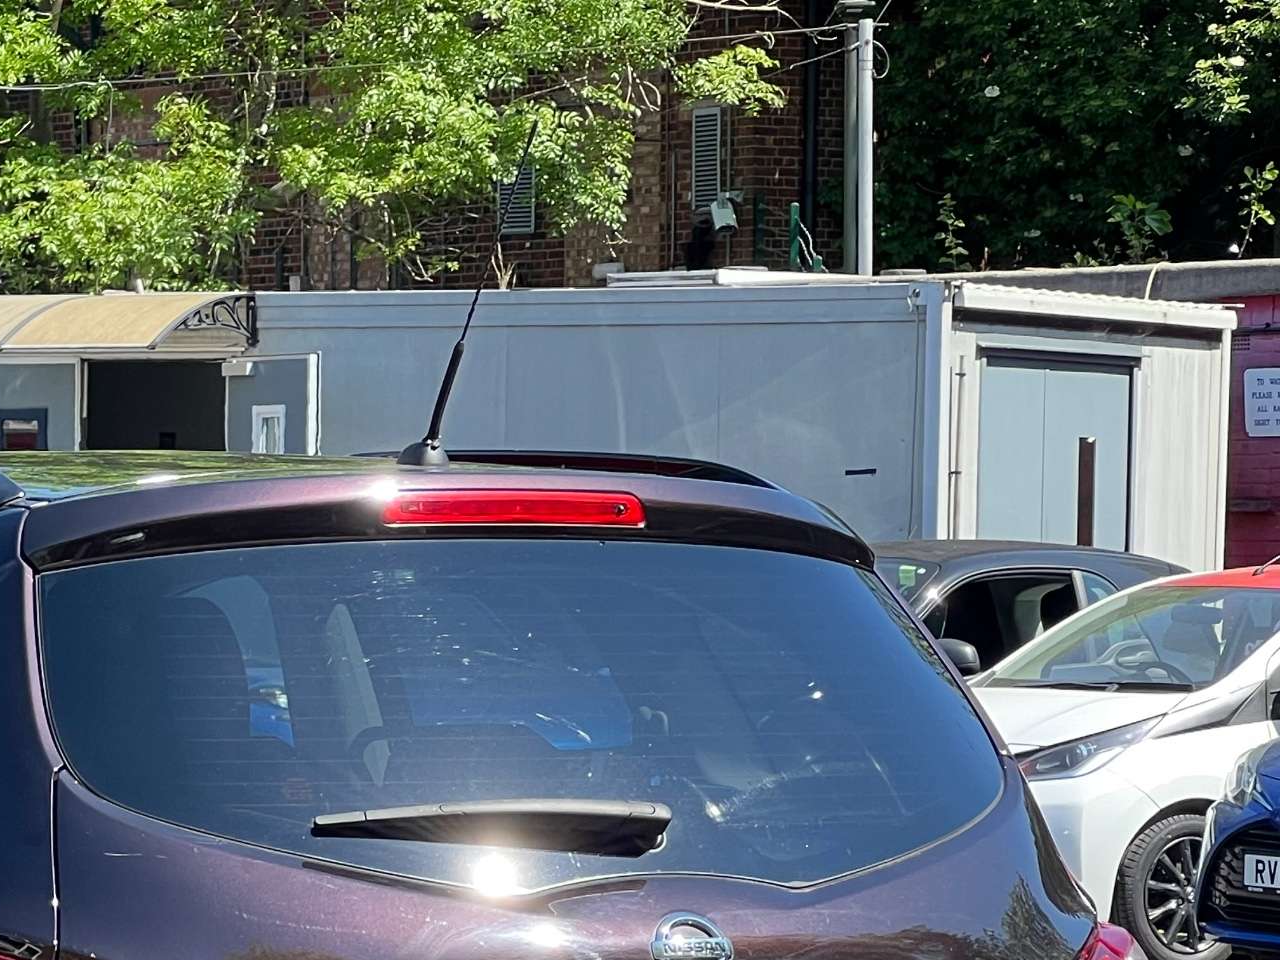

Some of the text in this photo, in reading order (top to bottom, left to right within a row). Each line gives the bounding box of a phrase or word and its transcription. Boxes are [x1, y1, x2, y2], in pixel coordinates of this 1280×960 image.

[1252, 391, 1272, 399] PLEASE
[1255, 858, 1278, 885] RV
[663, 941, 726, 954] NISSAN
